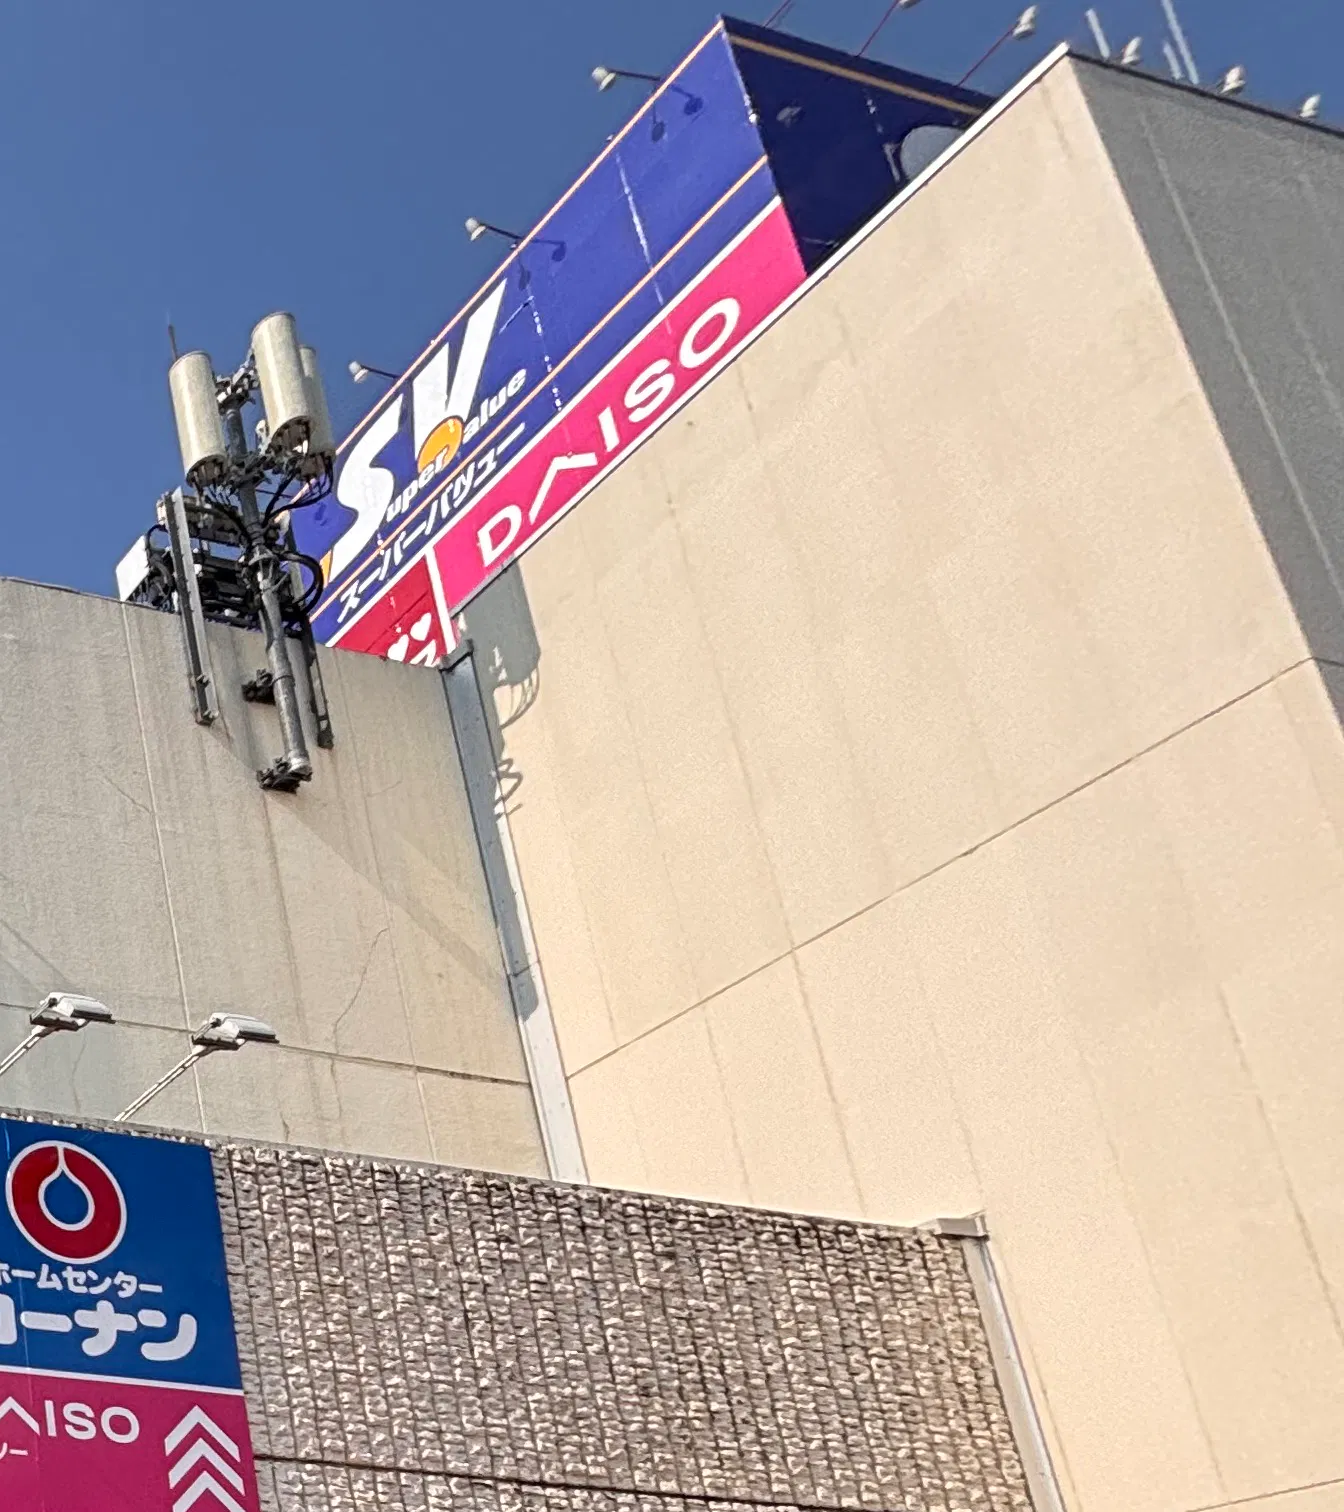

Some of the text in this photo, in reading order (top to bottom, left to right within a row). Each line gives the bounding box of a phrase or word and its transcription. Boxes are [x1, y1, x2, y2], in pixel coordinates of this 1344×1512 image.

[337, 423, 526, 623] スーパーバリュー
[477, 298, 741, 569] DAISO
